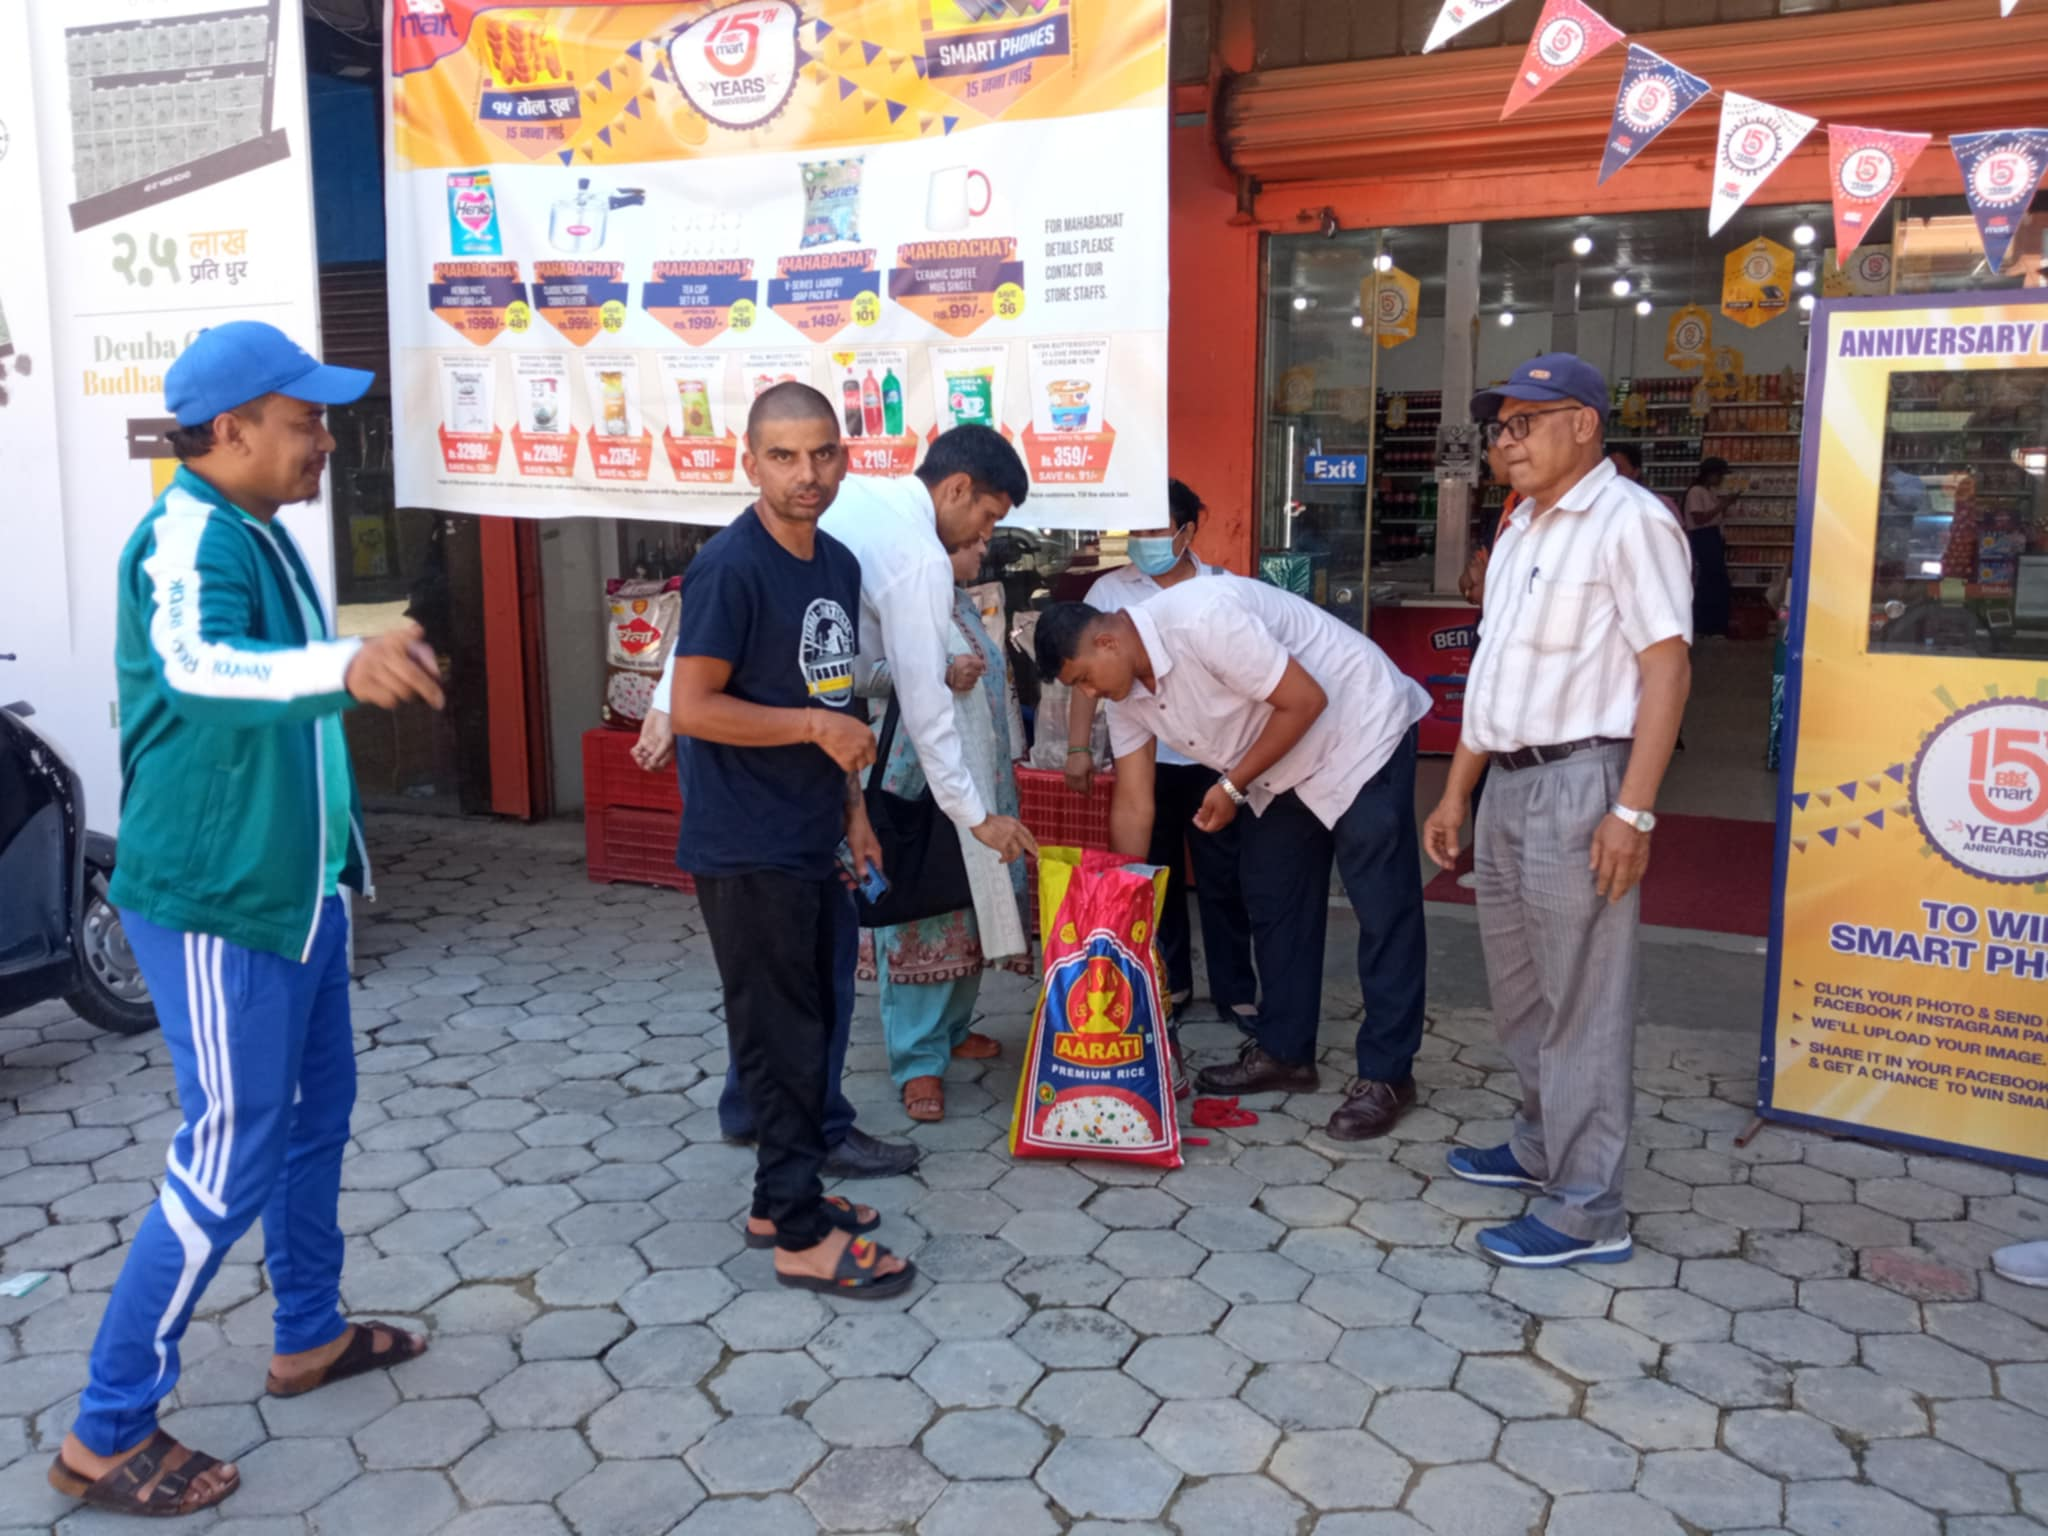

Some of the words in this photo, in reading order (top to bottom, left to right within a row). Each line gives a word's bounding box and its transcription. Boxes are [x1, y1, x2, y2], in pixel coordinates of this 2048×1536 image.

[939, 40, 997, 66] SMART
[1000, 24, 1055, 58] PHONES
[709, 77, 766, 97] YEARS
[1045, 219, 1063, 233] FOR
[1064, 212, 1124, 232] MAHABACHAT
[188, 229, 249, 259] लाख
[1045, 240, 1079, 257] DETAILS
[1081, 236, 1115, 254] PLEASE
[190, 259, 219, 285] प्रति
[225, 260, 249, 286] धुर
[915, 269, 948, 281] CERAMIC
[950, 267, 977, 279] COFFEE
[1045, 262, 1082, 280] CONTACT
[1085, 261, 1104, 277] OUR
[1045, 286, 1072, 303] STORE
[856, 310, 875, 321] 101
[1000, 303, 1016, 315] 36
[93, 331, 177, 363] Deuba
[1839, 323, 2035, 358] ANNIVERSARY
[1054, 445, 1094, 467] 359/-
[1039, 471, 1064, 481] SAVE
[1314, 460, 1358, 479] Exit
[1987, 786, 2033, 803] mart
[1965, 823, 2048, 850] YEARS
[1963, 841, 2048, 861] ANNIVERSARY
[1921, 900, 1978, 934] TO
[1830, 923, 1978, 969] SMART
[1985, 943, 2048, 980] PH
[1814, 980, 1864, 1000] CLICK
[1868, 989, 1912, 1008] YOUR
[1916, 998, 1975, 1018] PHOTO
[1978, 1006, 1990, 1020] &
[1994, 1008, 2043, 1028] SEND
[1814, 995, 1902, 1021] FACEBOOK
[1917, 1011, 2020, 1040] INSTAGRAM
[1057, 1038, 1141, 1059] AARATI
[1812, 1016, 1860, 1035] WE'LL
[1863, 1024, 1931, 1048] UPLOAD
[1935, 1036, 1981, 1056] YOUR
[1984, 1045, 2048, 1067] IMAGE.
[1809, 1041, 1864, 1062] SHARE
[1867, 1051, 1882, 1065] IT
[1885, 1054, 1902, 1068] IN
[1907, 1058, 1953, 1078] YOUR
[1051, 1063, 1111, 1081] PREMIUM
[1116, 1066, 1146, 1079] RICE
[1808, 1057, 1820, 1069] &
[1823, 1060, 1854, 1075] GET
[1857, 1066, 1868, 1079] A
[1871, 1067, 1938, 1091] CHANCE
[1947, 1081, 1967, 1096] TO
[1971, 1084, 2003, 1103] WIN
